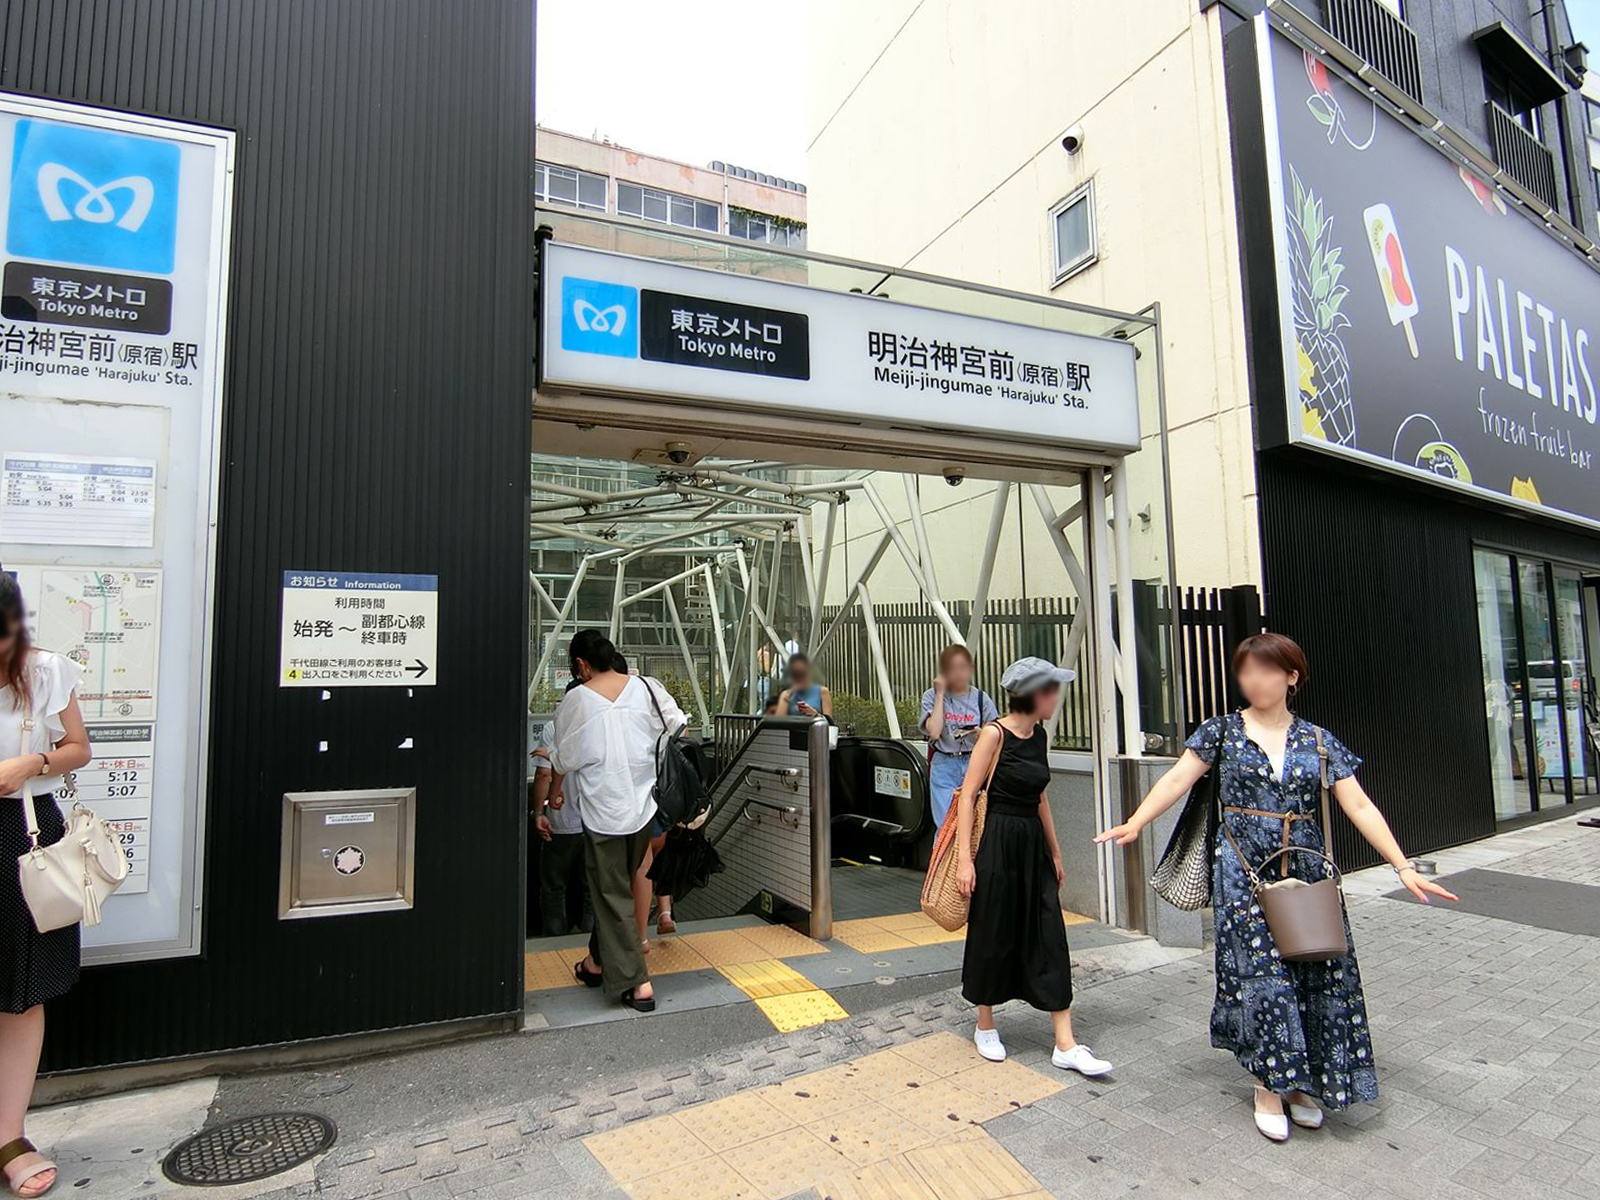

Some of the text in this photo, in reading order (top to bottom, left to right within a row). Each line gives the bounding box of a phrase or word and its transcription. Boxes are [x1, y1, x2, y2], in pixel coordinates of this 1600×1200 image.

[31, 276, 146, 307] 東京メトロ
[38, 298, 138, 321] Tokyo Metro
[671, 309, 782, 345] 東京メトロ
[1445, 245, 1598, 424] PALETAS
[678, 335, 776, 362] Tokyo Metro
[95, 366, 160, 383] 'Harajuku'
[165, 371, 193, 386] Sta.
[874, 366, 1089, 410] Meiji-jingumae 'Harajuku' Sta.
[1477, 387, 1592, 469] frozen fruit bar
[290, 576, 401, 590] お知らせ Information
[335, 597, 385, 610] 利用時間
[361, 614, 426, 630] 副都心線
[361, 632, 407, 645] 終車時
[290, 658, 402, 668] 千代田線ご利用のお客様は
[289, 670, 403, 679] 4 出入口をご利用ください
[108, 771, 137, 782] 5:12
[108, 785, 137, 797] 5:07
